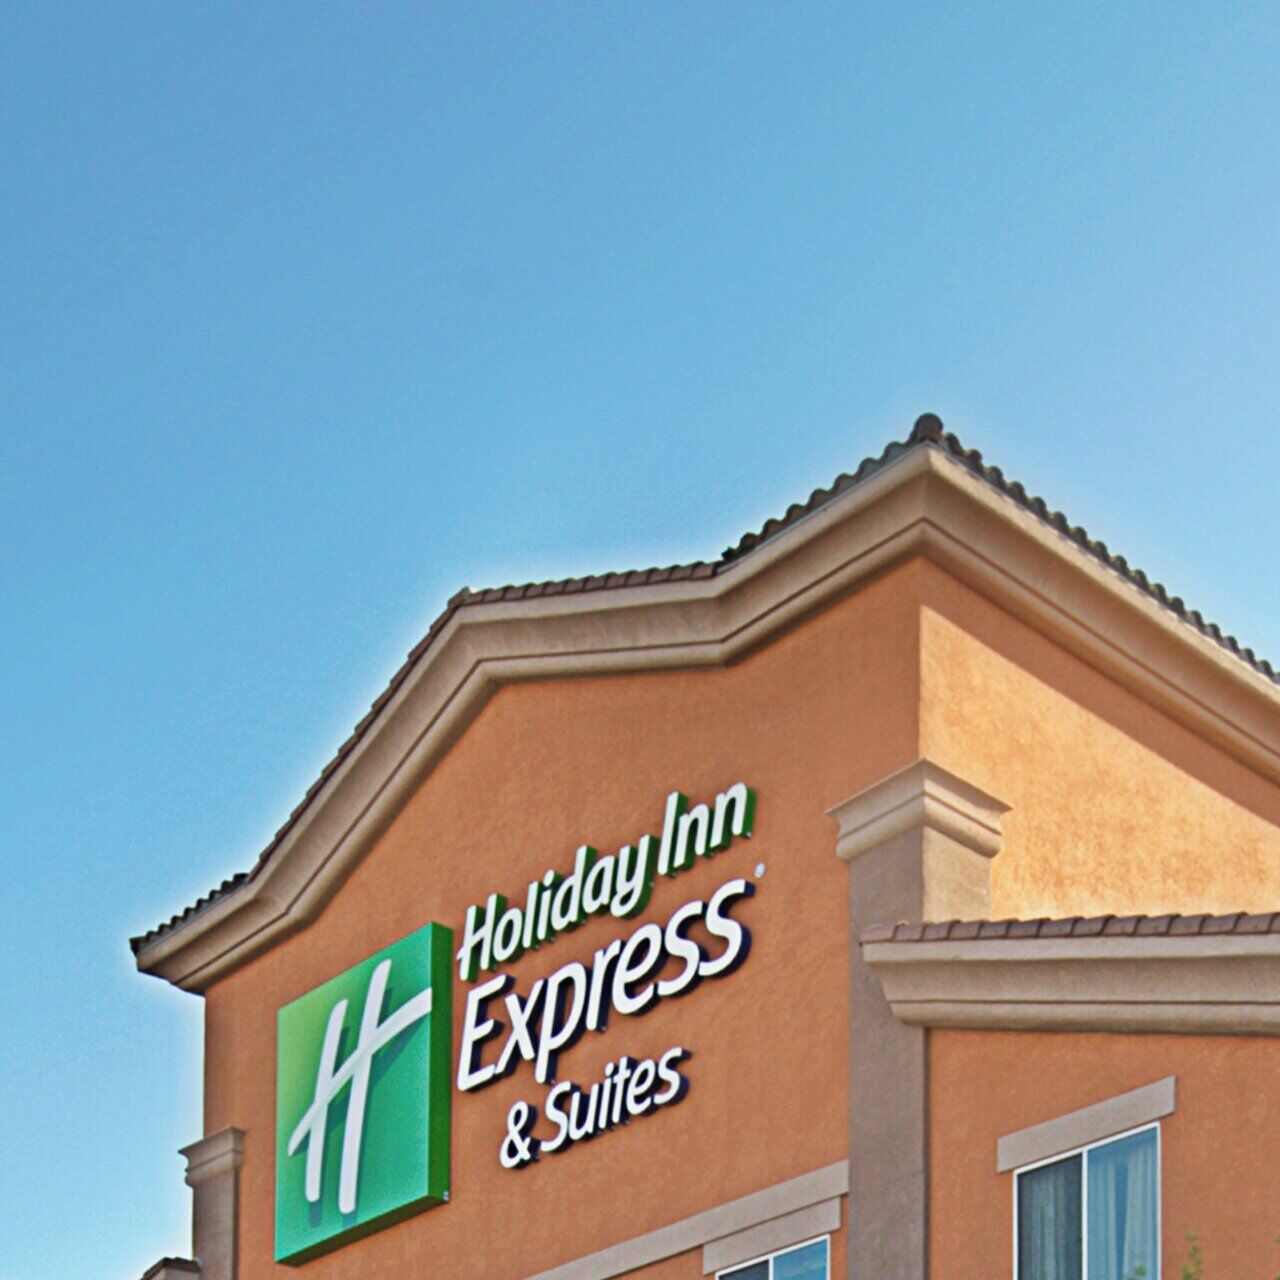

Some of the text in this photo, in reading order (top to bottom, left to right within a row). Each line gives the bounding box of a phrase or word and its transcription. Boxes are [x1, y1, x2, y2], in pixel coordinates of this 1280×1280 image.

[456, 782, 753, 983] Holiday Inn
[457, 878, 751, 1092] Express
[499, 1046, 688, 1169] & Suites
